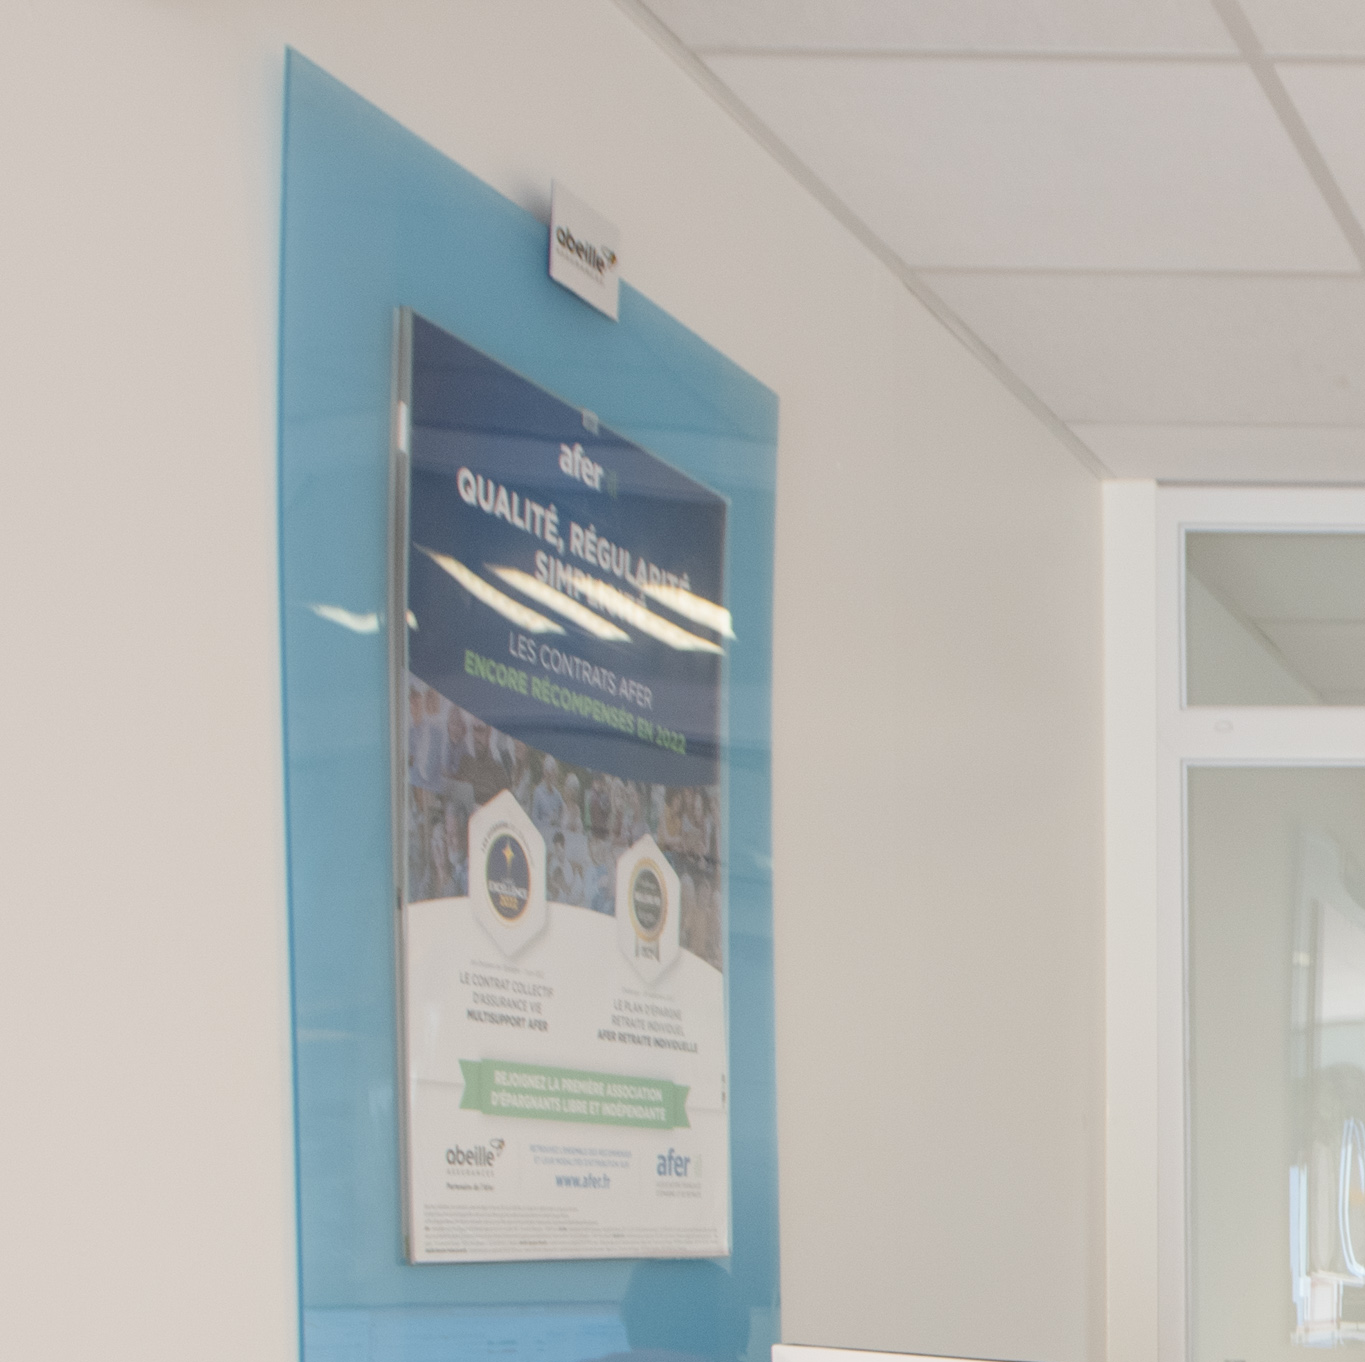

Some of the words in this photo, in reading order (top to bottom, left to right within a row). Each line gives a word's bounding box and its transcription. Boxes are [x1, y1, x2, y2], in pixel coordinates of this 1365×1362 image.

[556, 226, 605, 275] abeille
[559, 442, 604, 491] afer
[456, 466, 565, 556] QUALITÉ,
[509, 631, 537, 665] LES
[539, 644, 617, 697] CONTRATS
[618, 676, 653, 710] AFER
[464, 649, 528, 696] ENCORE
[637, 715, 654, 742] EN
[446, 1144, 495, 1166] abeille
[656, 1147, 691, 1177] afer
[555, 1172, 611, 1189] www.afer.fr
